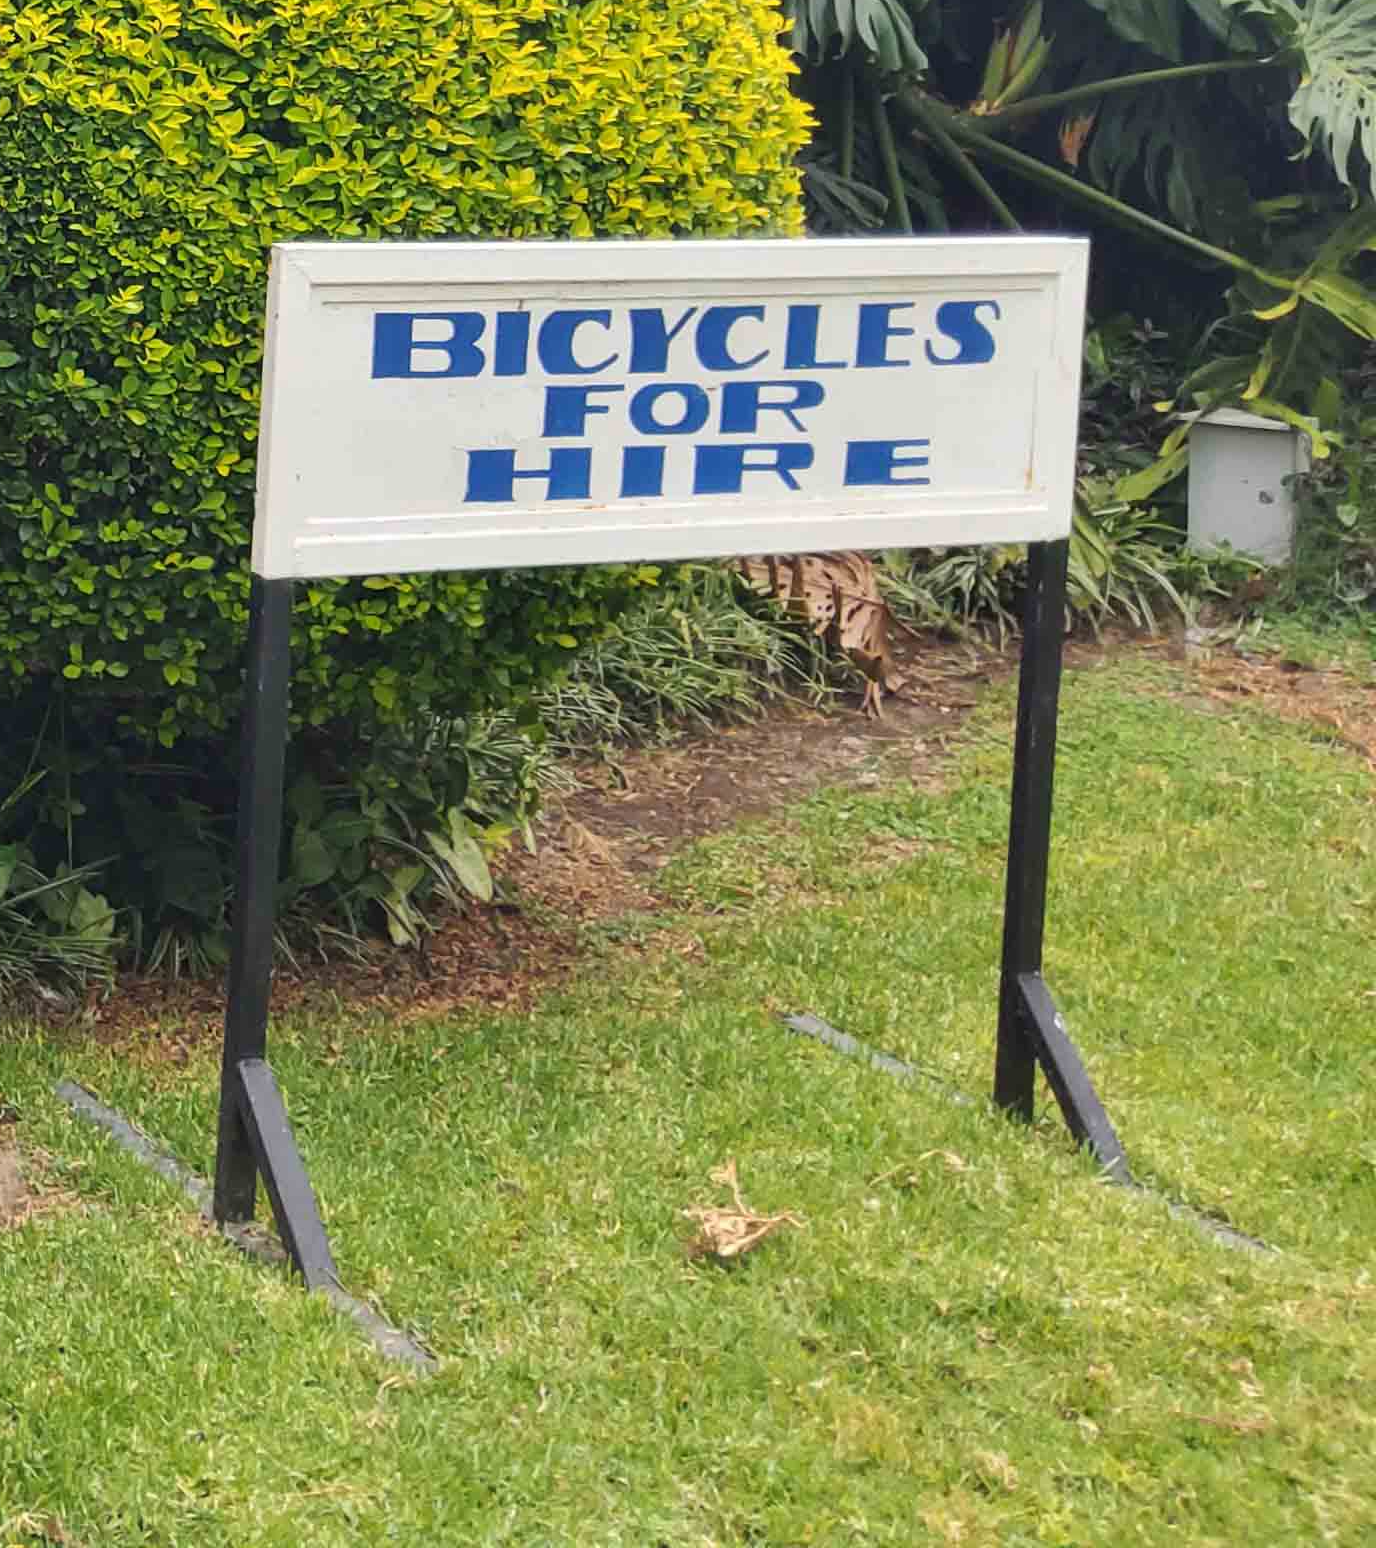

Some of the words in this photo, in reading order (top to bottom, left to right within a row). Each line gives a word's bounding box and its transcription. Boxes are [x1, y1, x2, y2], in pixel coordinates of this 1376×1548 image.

[371, 299, 1001, 380] BICYCLES
[540, 379, 825, 438] FOR
[462, 438, 932, 503] HIRE
